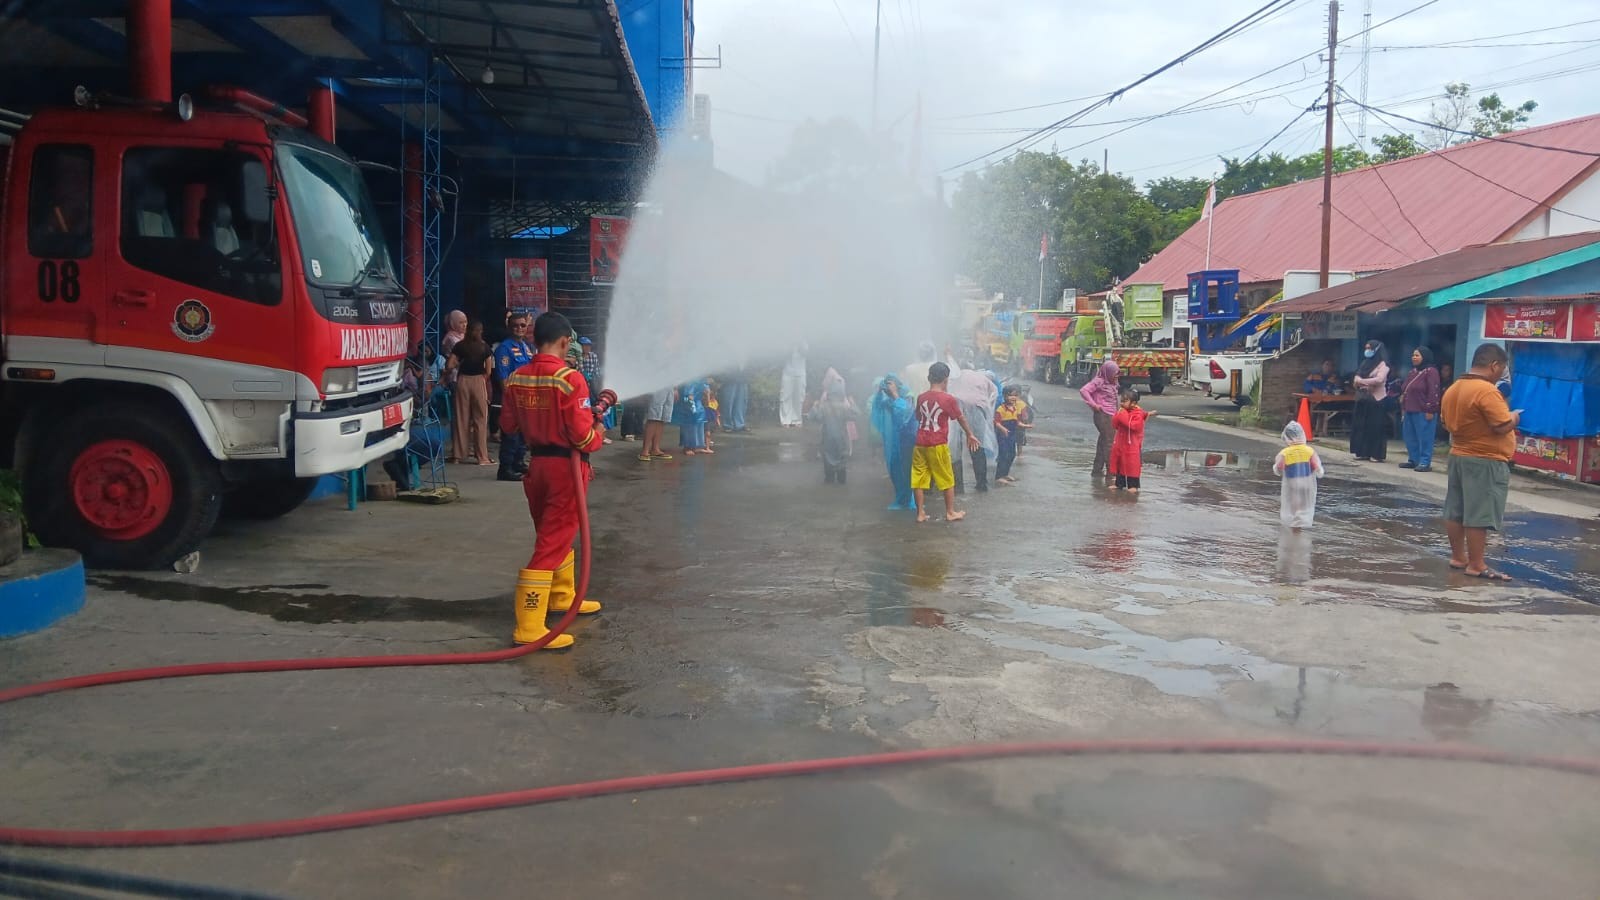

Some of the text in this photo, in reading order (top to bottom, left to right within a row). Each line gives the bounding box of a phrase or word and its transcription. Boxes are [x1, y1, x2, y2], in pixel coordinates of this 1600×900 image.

[38, 260, 81, 302] 08
[369, 302, 397, 319] ISUZU
[919, 400, 943, 432] NY
